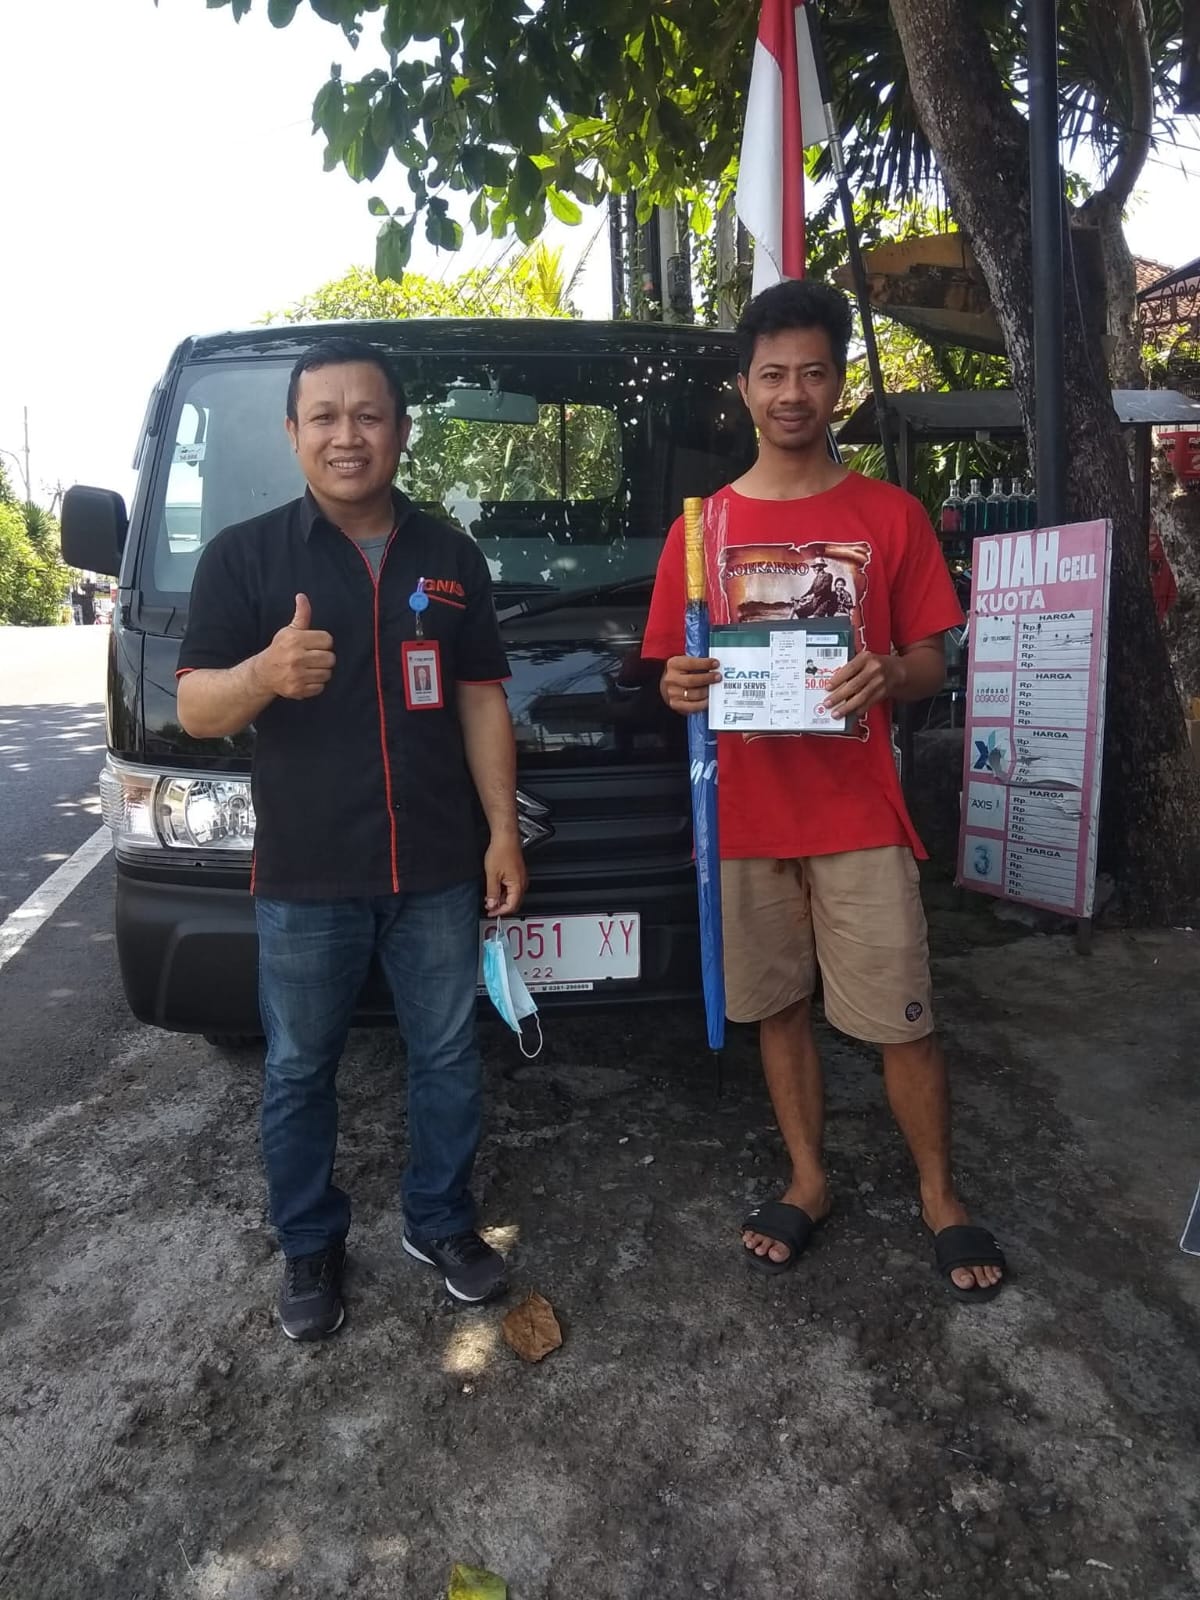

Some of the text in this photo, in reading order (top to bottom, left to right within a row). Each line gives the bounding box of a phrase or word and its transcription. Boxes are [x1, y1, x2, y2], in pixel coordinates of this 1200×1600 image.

[977, 531, 1097, 591] DIAH CELL
[726, 561, 810, 579] SOEKARNO
[421, 578, 465, 597] GNIS
[976, 589, 1046, 613] KUOTA
[1039, 613, 1075, 621] HARGA
[743, 682, 766, 690] SERVIS
[1033, 731, 1069, 739] HARGA
[1029, 790, 1064, 799] HARGA
[971, 799, 993, 810] AXIS
[1026, 847, 1061, 858] HARGA
[974, 846, 990, 875] 3
[599, 920, 635, 957] XY
